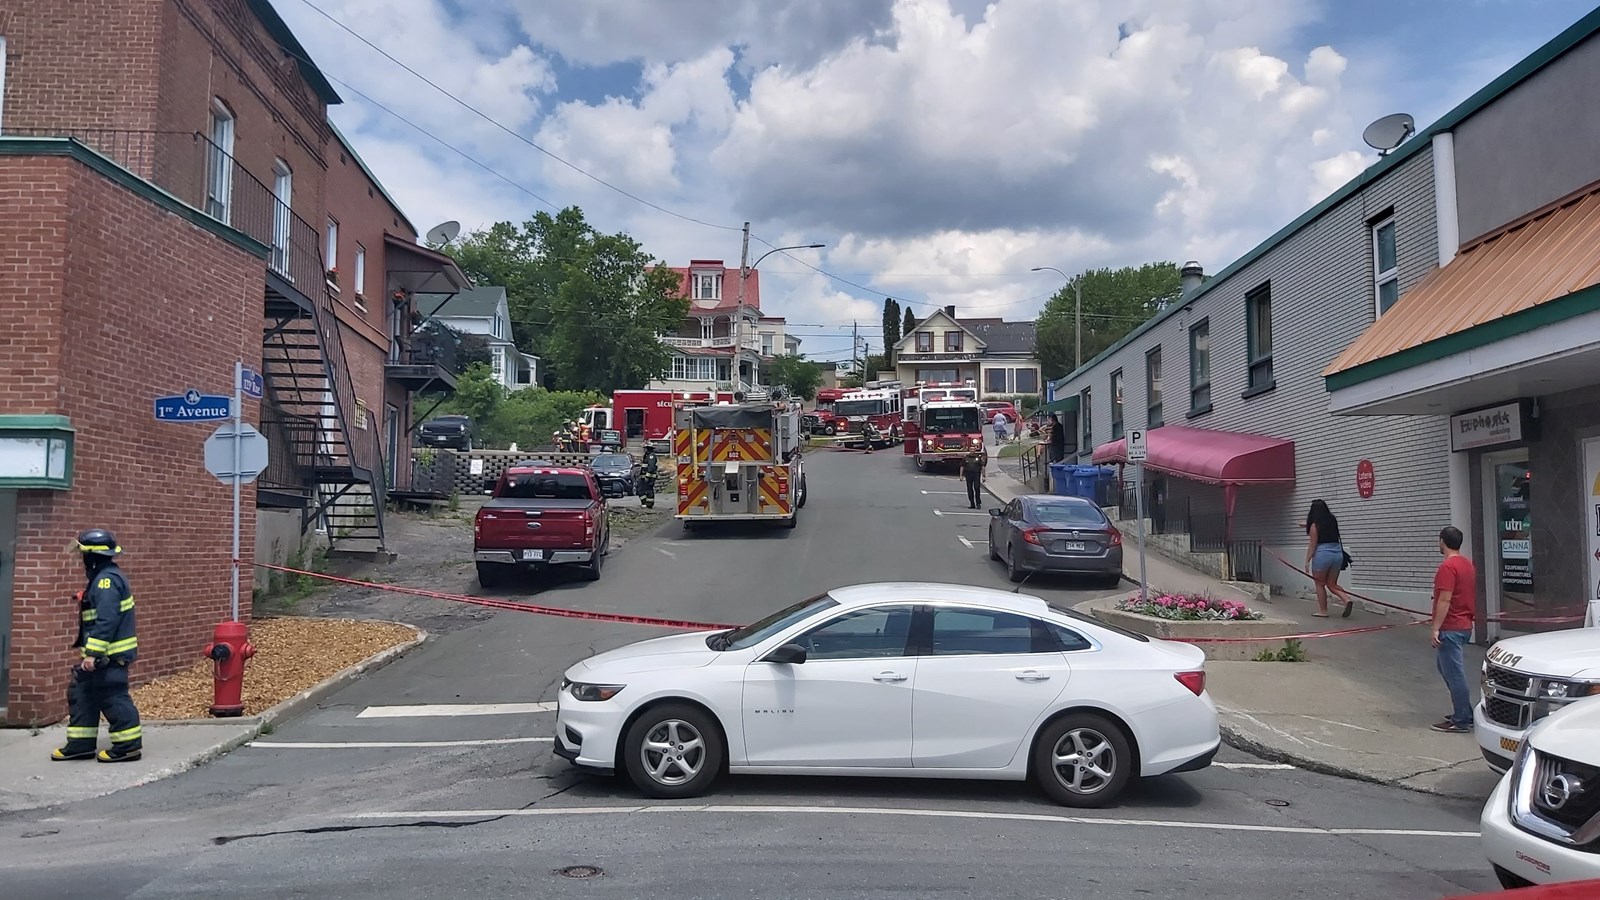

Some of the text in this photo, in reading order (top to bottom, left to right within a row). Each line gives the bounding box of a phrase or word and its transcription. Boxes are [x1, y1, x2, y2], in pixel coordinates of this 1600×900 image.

[656, 400, 673, 408] SÉCU
[176, 406, 227, 417] Avenue
[1132, 431, 1141, 444] P
[1502, 541, 1529, 550] CANNA
[98, 578, 111, 589] 48
